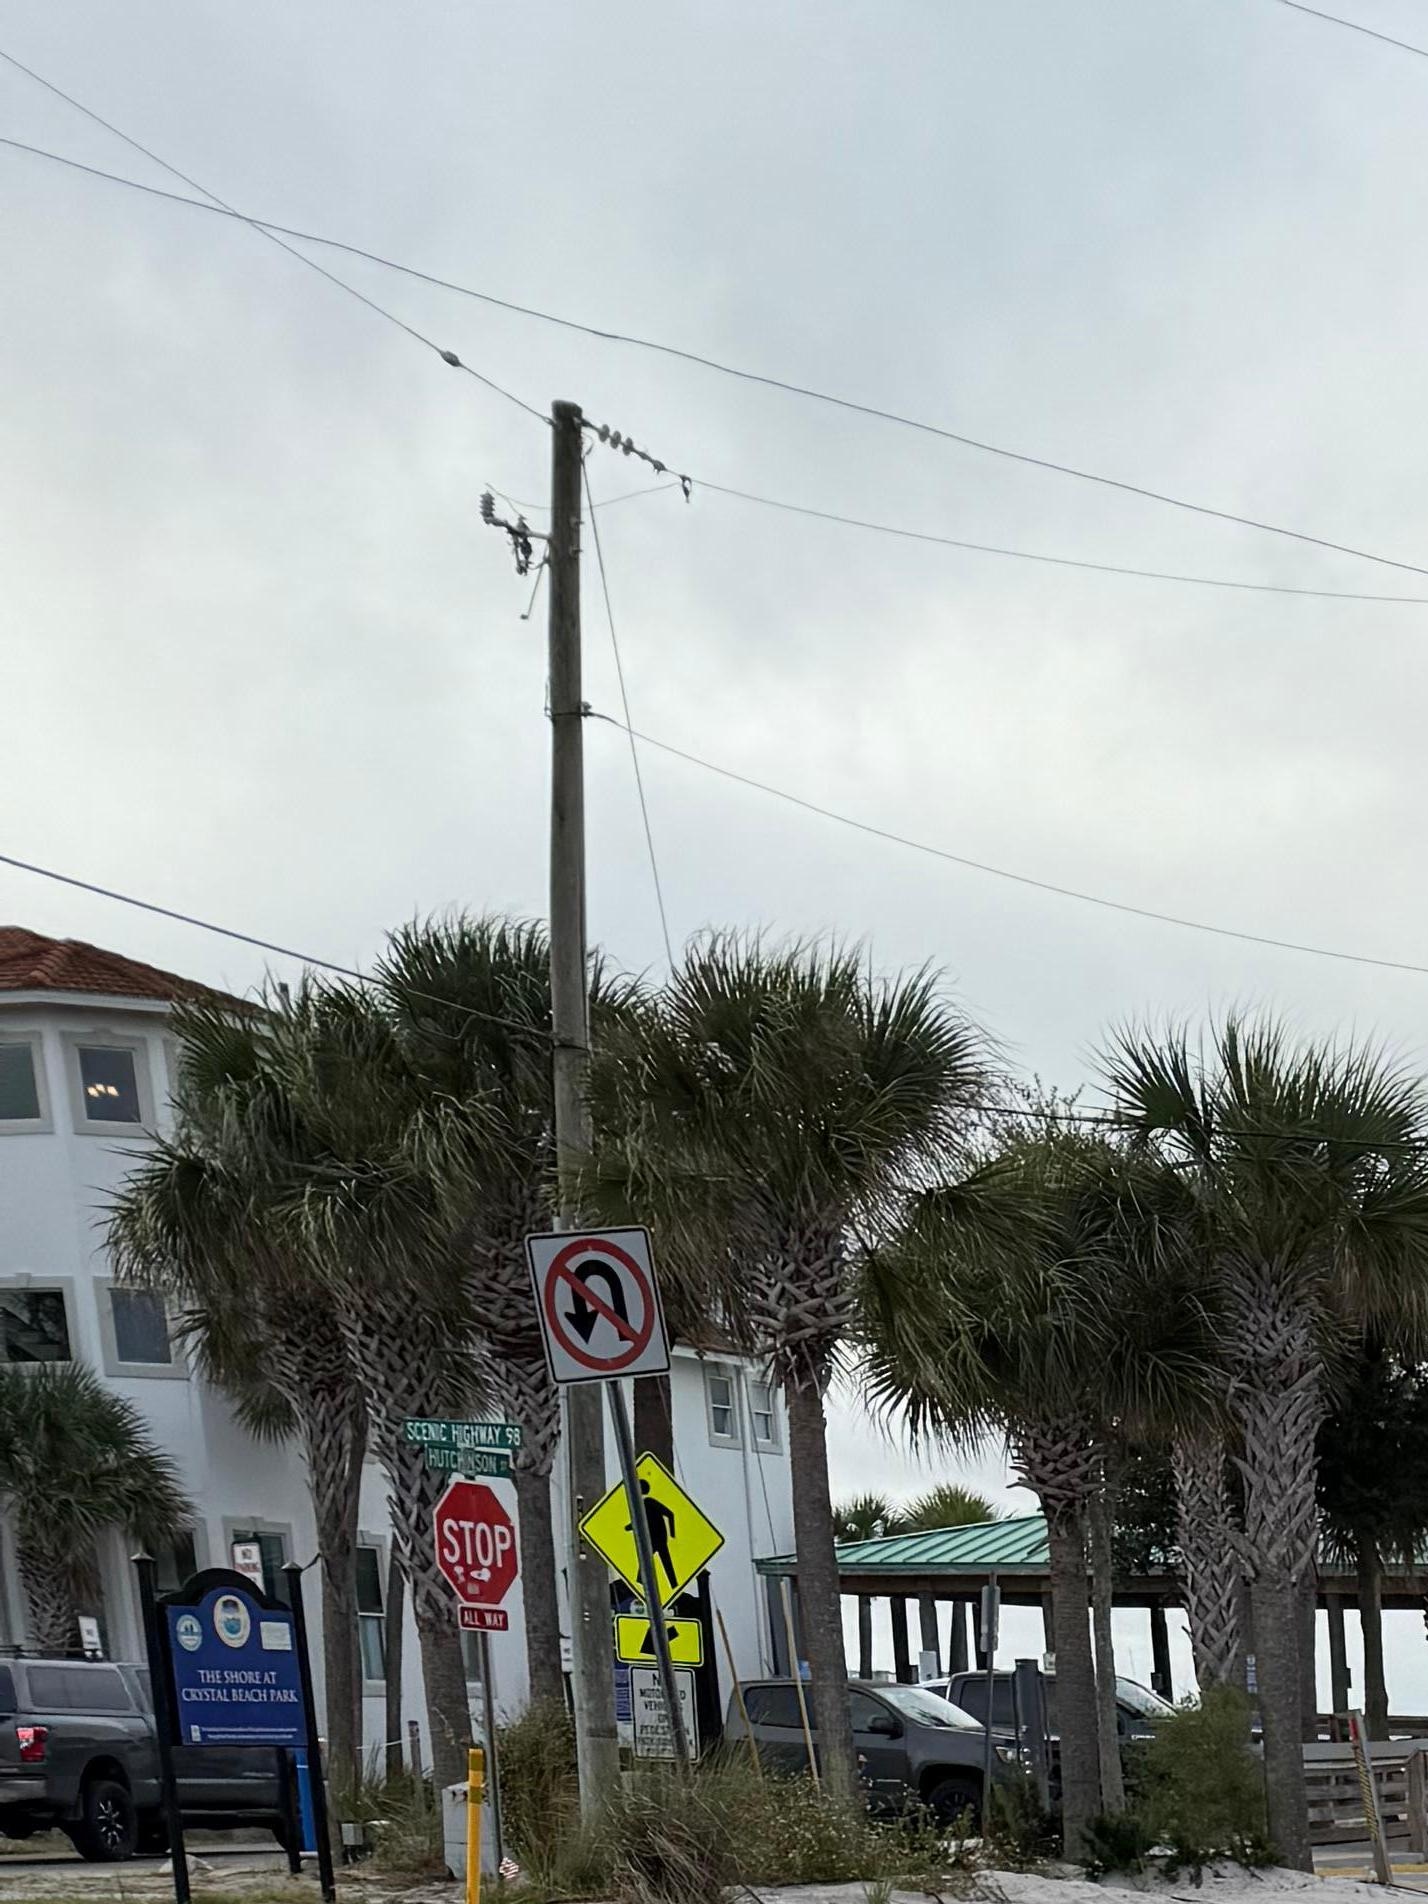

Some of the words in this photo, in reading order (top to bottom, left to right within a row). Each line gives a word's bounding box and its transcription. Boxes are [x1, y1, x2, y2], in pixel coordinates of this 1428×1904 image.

[405, 1421, 447, 1441] SCENIC
[451, 1424, 501, 1446] HIGHWAY
[505, 1427, 521, 1446] 98
[443, 1518, 512, 1568] STOP
[463, 1610, 479, 1625] ALL
[484, 1611, 505, 1627] WAY
[198, 1669, 223, 1684] THE
[224, 1671, 262, 1685] SHORE
[263, 1671, 277, 1684] AT
[181, 1688, 230, 1702] CRYSTAL
[232, 1689, 268, 1702] BEACH
[270, 1690, 299, 1703] PARK
